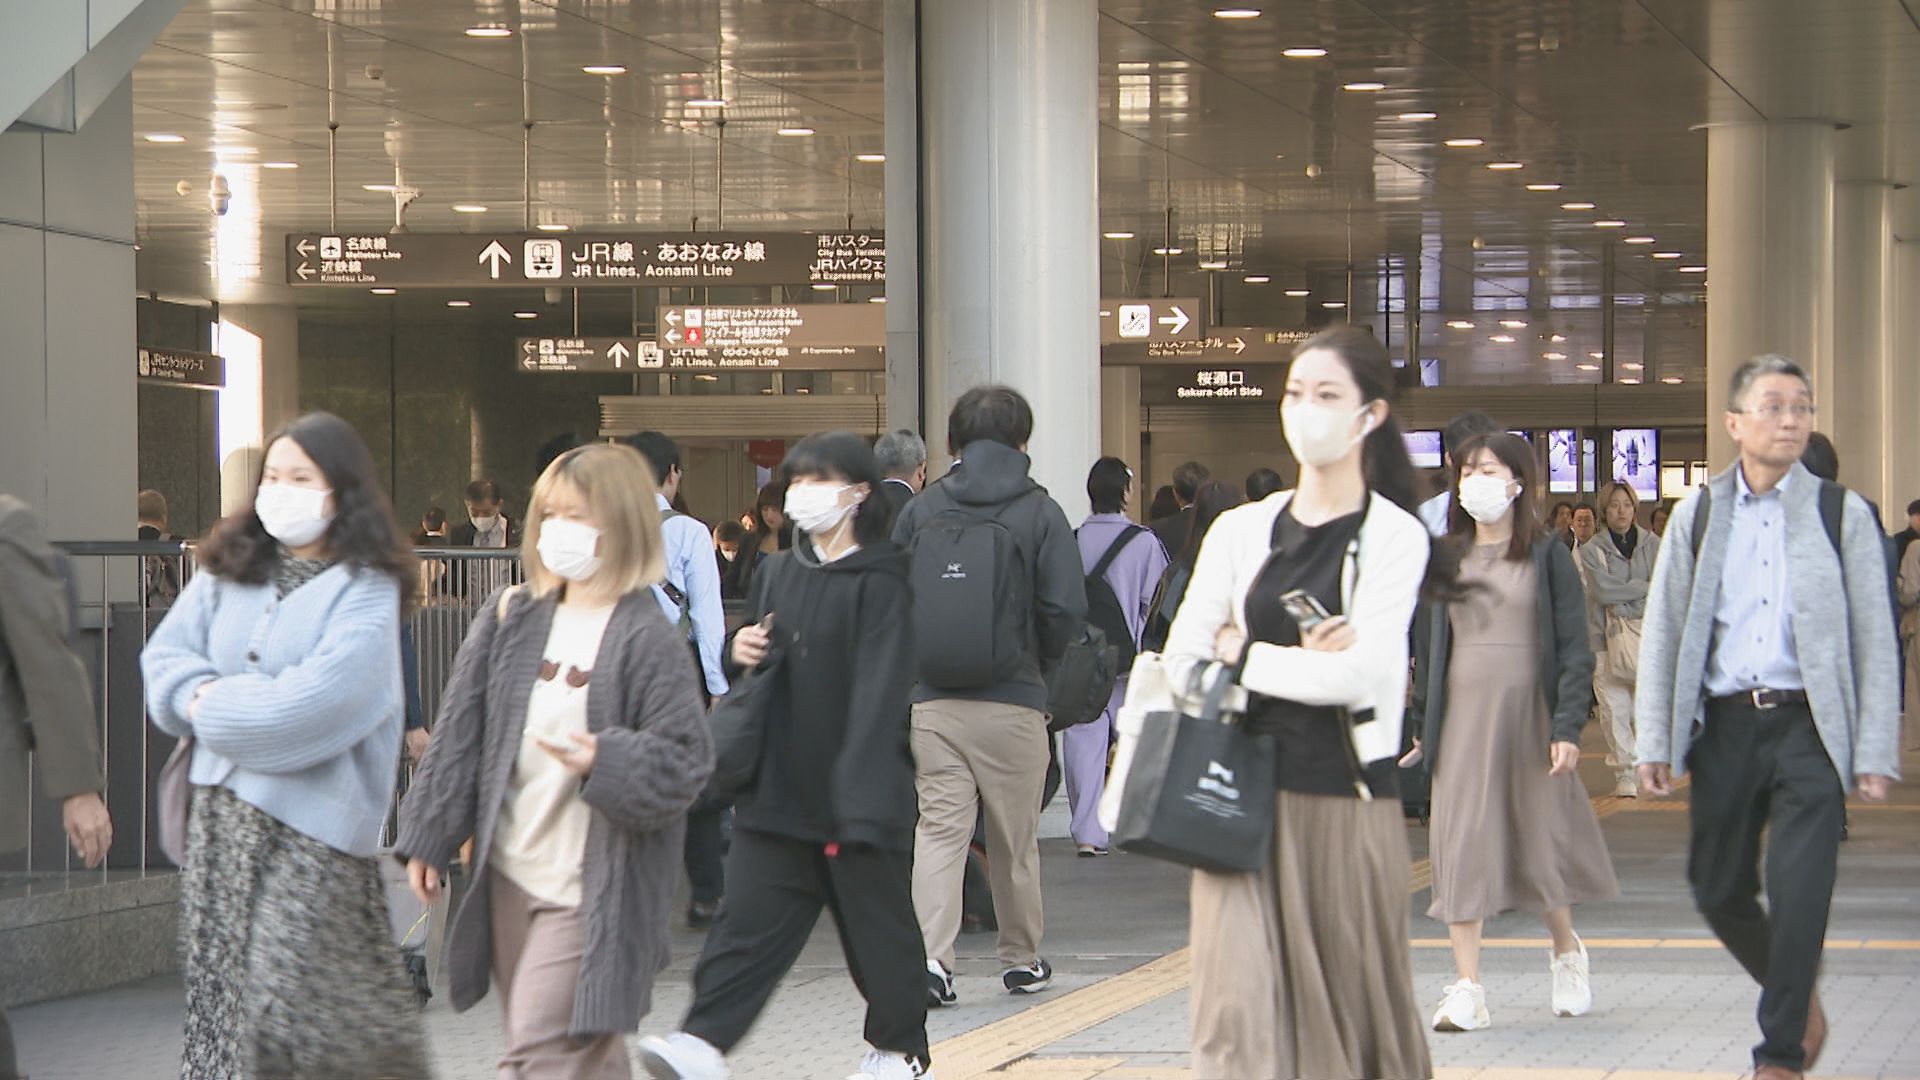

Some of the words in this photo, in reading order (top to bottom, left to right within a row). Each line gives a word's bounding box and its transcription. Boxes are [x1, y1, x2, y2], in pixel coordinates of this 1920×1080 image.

[571, 264, 592, 277] JR
[596, 264, 641, 278] Lines,
[645, 264, 698, 277] Aonami
[702, 264, 733, 277] Line
[669, 357, 684, 367] JR
[719, 357, 756, 366] Aonami
[757, 357, 780, 367] Line
[1239, 386, 1264, 397] Side
